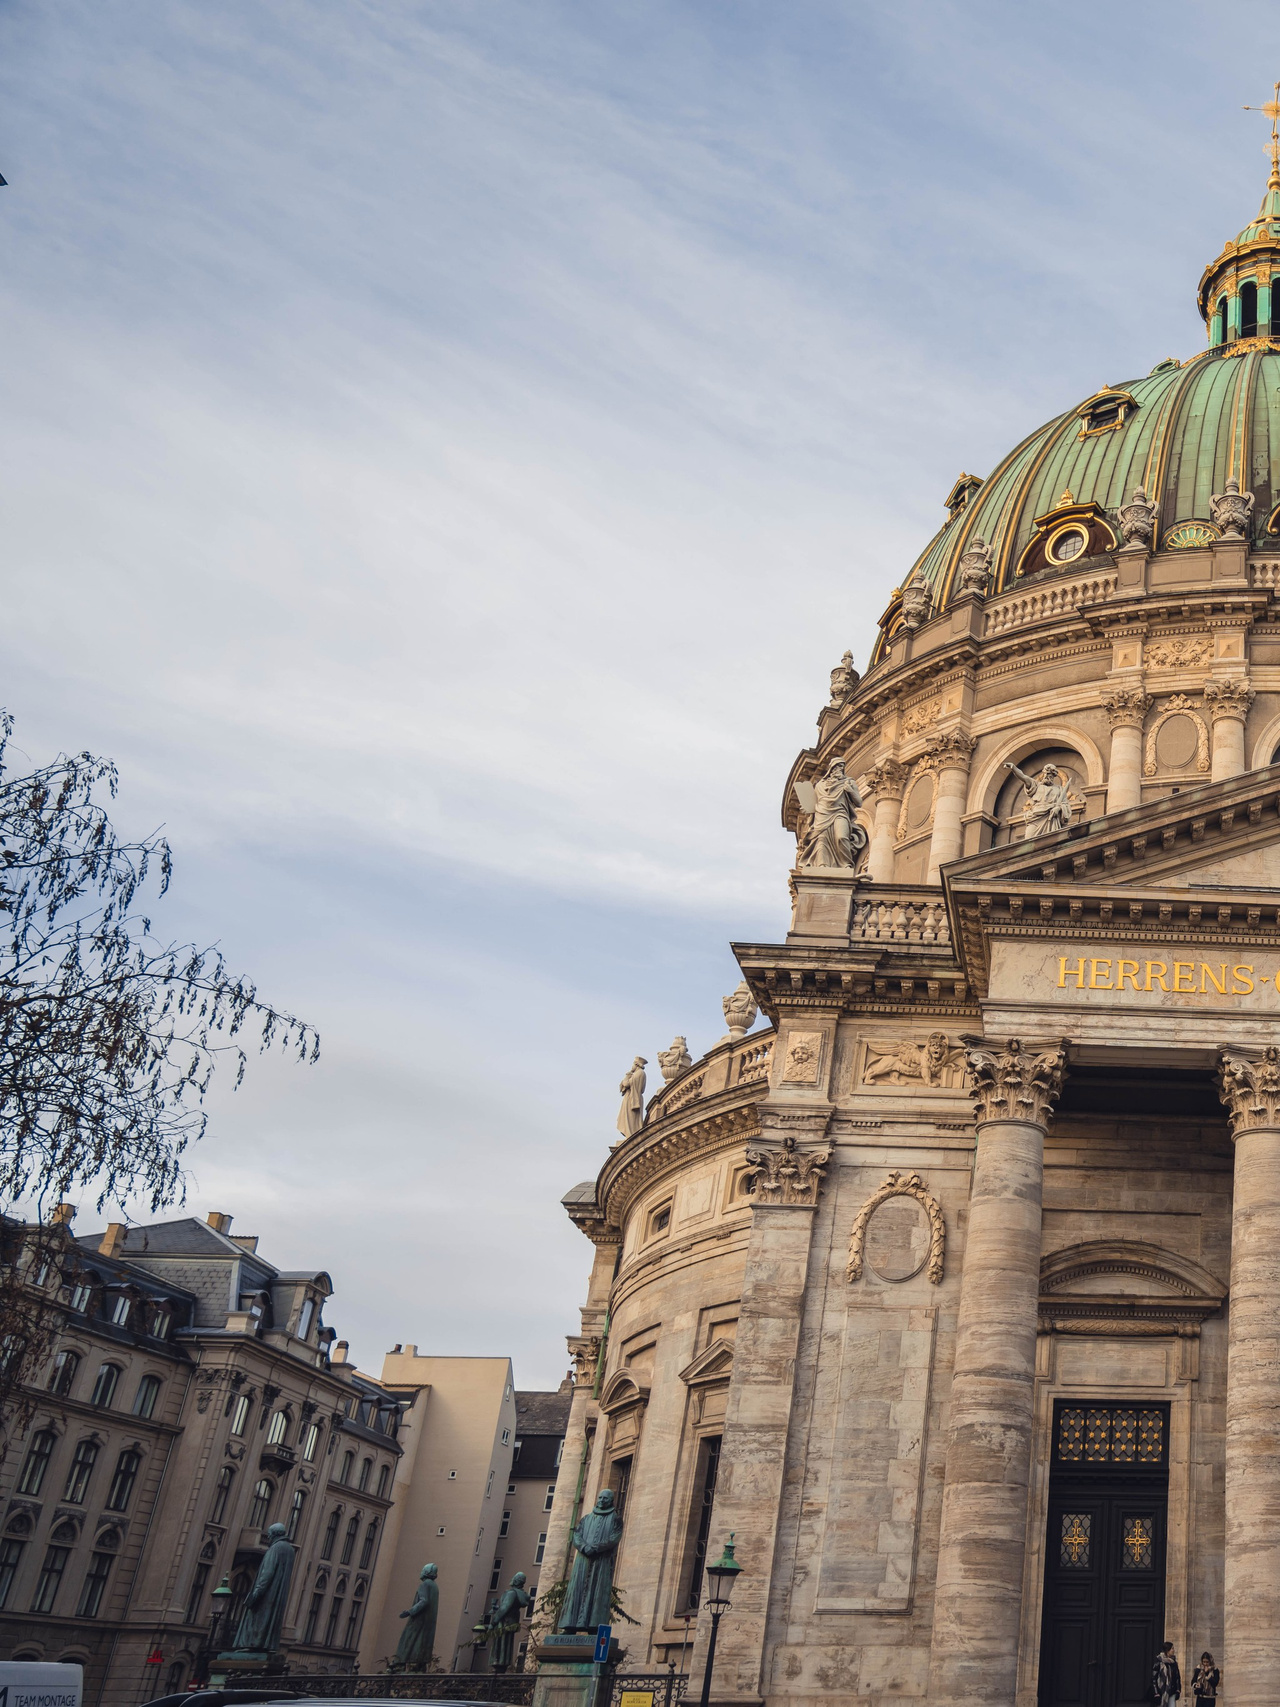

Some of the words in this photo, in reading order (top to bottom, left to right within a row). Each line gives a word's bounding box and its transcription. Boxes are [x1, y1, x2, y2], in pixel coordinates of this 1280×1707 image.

[1057, 957, 1255, 995] HERRENS
[14, 1695, 37, 1707] TEAM
[37, 1694, 76, 1707] MONTAGE
